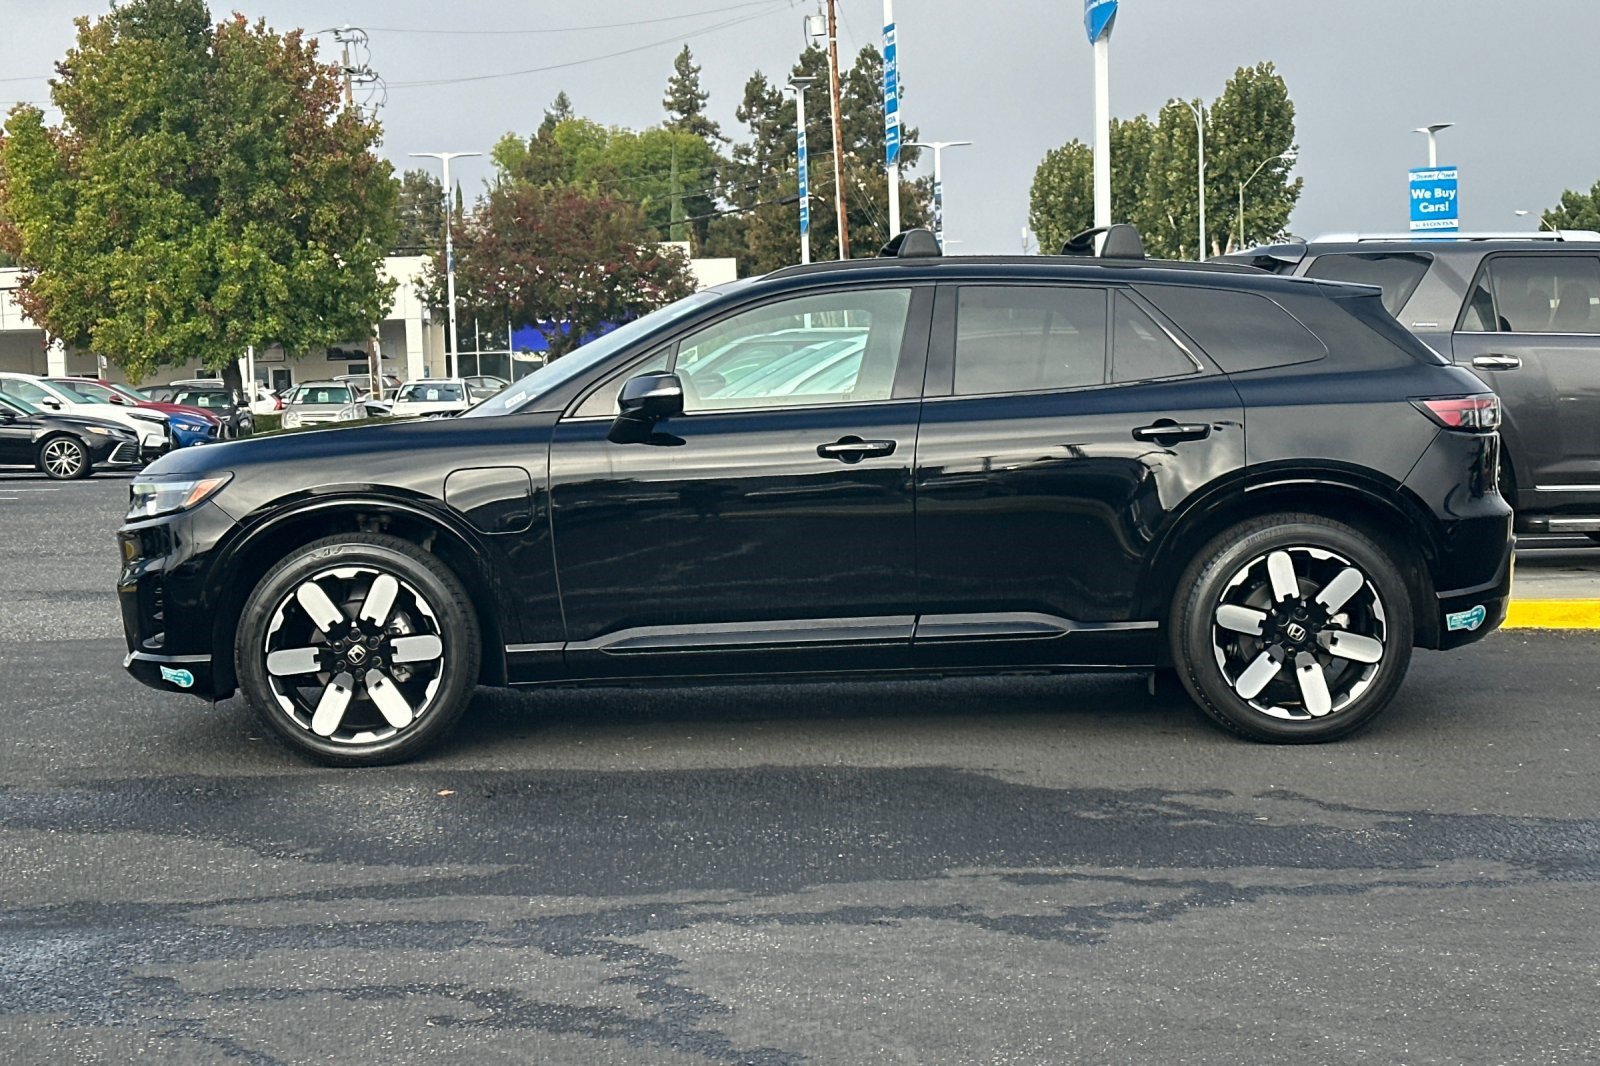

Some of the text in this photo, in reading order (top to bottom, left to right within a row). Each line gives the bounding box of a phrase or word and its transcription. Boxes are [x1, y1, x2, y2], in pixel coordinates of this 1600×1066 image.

[1411, 187, 1456, 200] We Buy
[1419, 201, 1449, 212] Cars!
